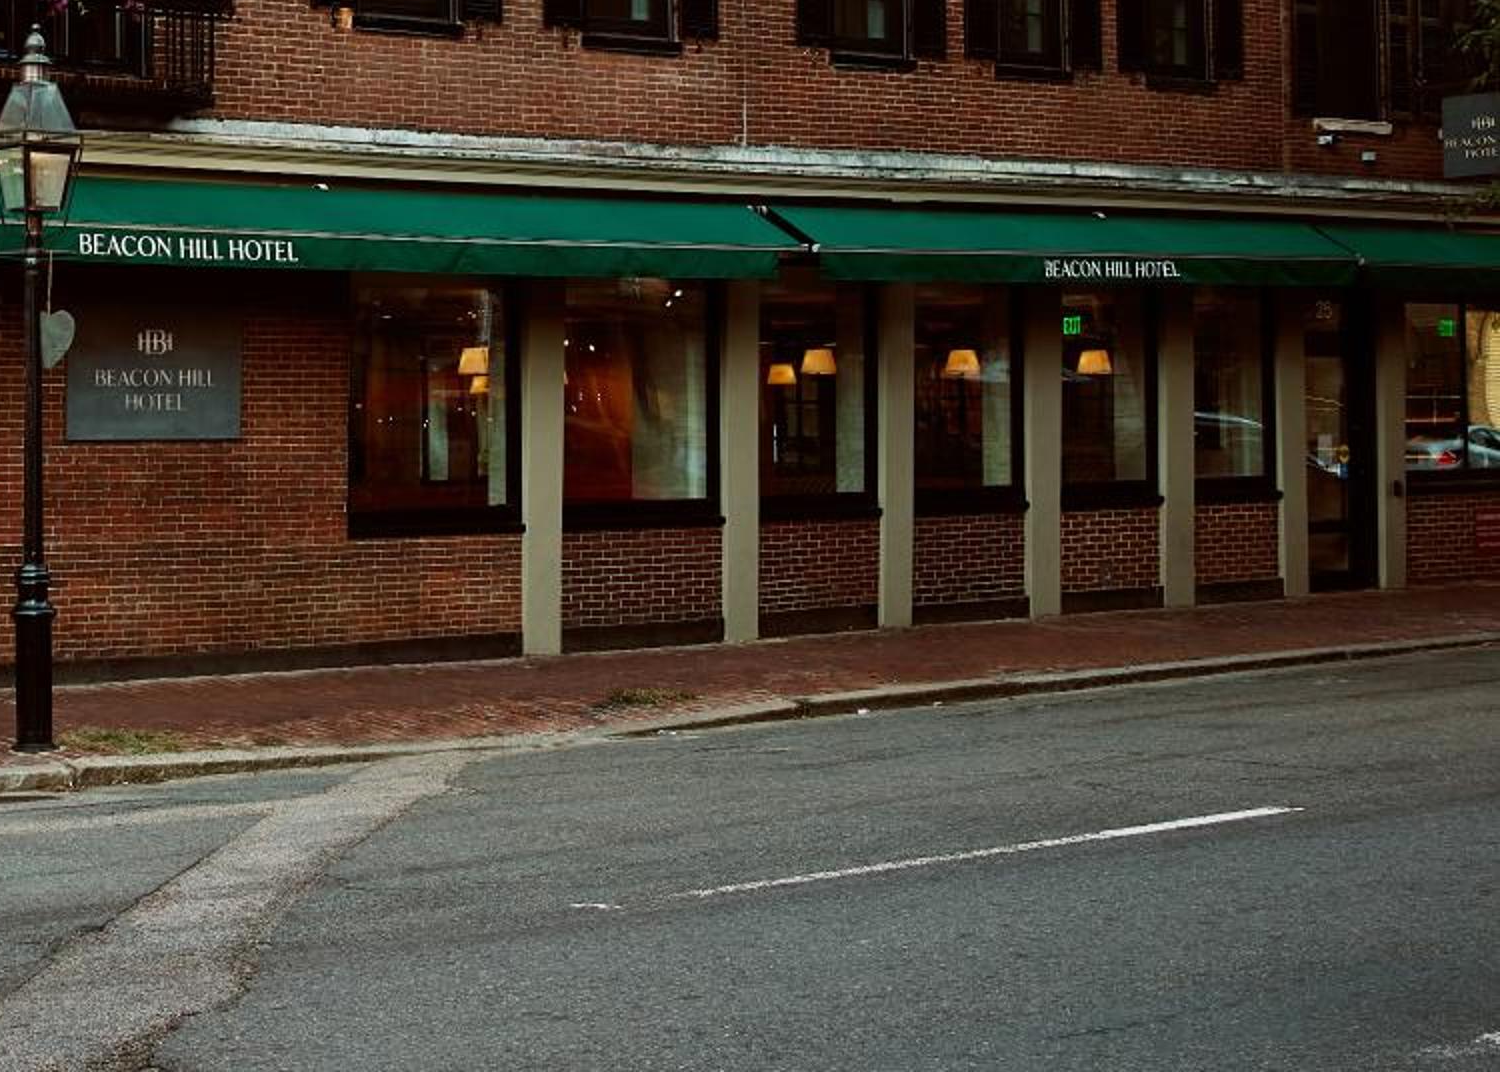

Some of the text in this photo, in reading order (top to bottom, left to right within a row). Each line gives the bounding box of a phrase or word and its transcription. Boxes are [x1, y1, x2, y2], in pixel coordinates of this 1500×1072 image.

[1465, 147, 1500, 160] HOTE
[79, 233, 298, 262] BEACON HILL HOTEL
[1044, 259, 1181, 278] BEACON HILL HOTEL
[95, 369, 215, 387] BEACON HILL
[125, 393, 187, 411] HOTEL
